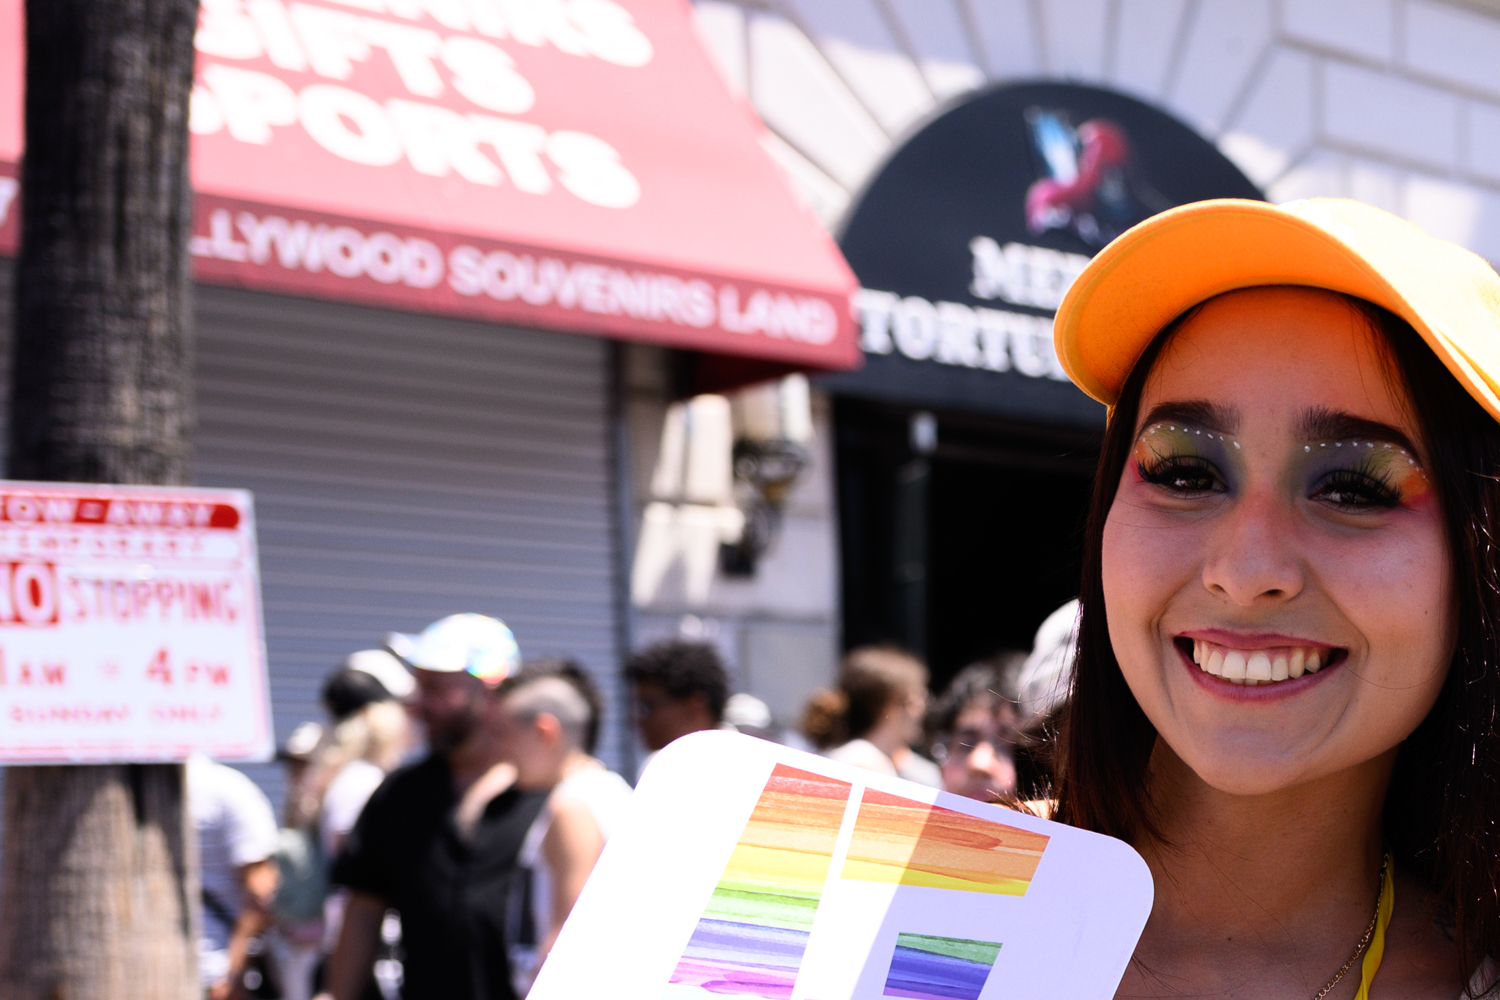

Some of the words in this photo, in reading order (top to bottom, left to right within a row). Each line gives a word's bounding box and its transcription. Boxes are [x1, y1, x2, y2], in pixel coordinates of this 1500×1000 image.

[449, 245, 716, 328] SOUVENIRS
[718, 284, 838, 346] LAND
[3, 496, 212, 529] OW-AWAY
[66, 577, 240, 622] STOPPING
